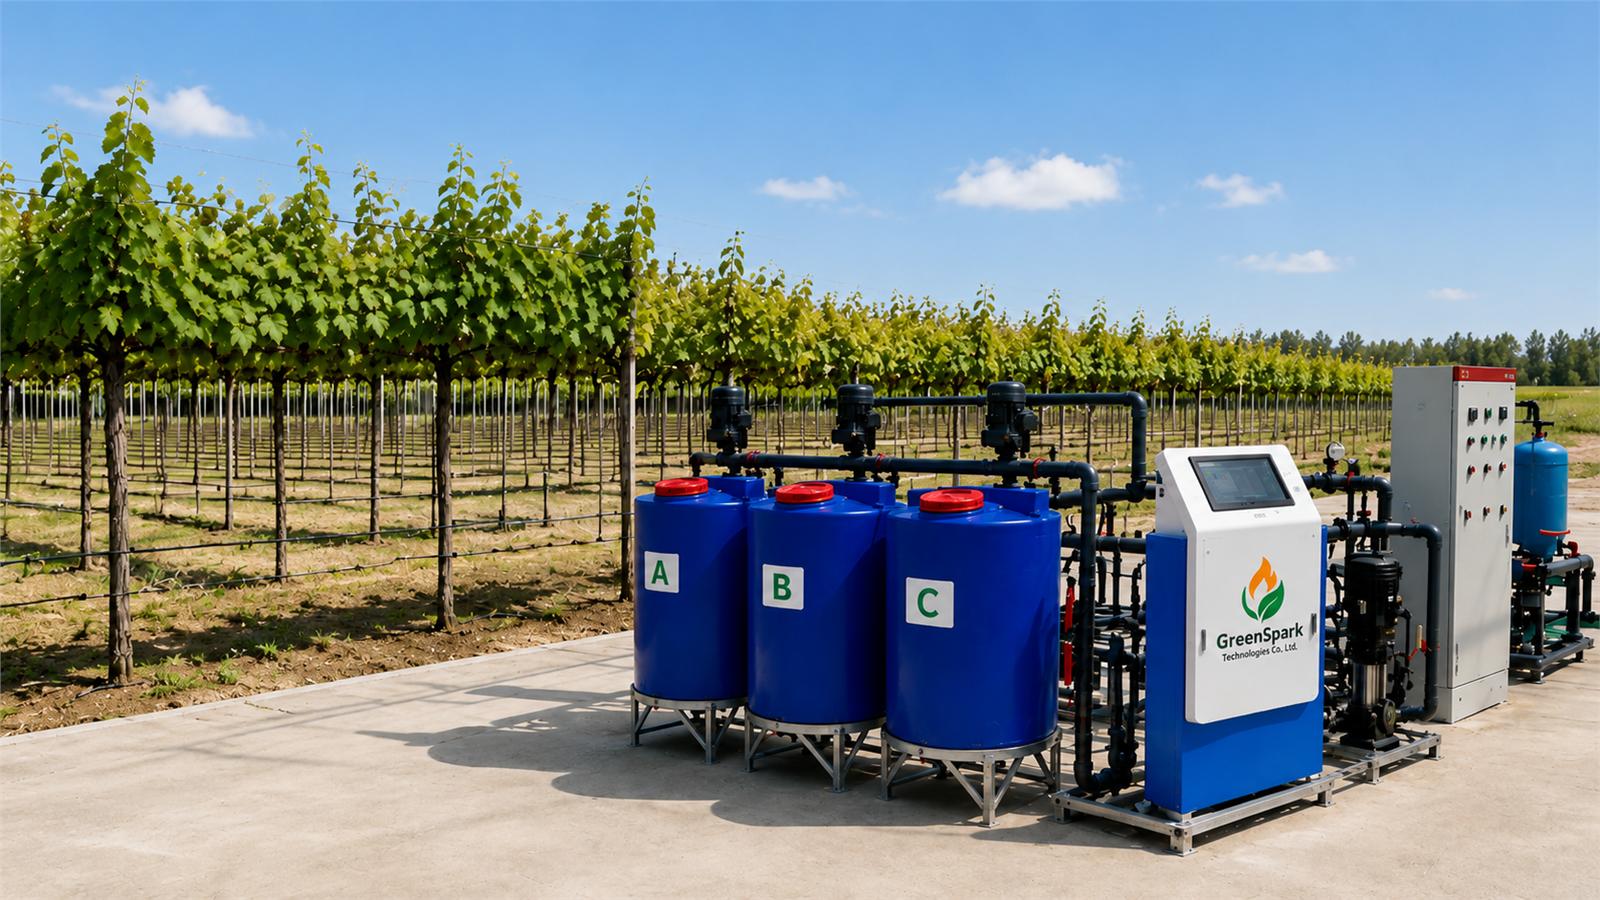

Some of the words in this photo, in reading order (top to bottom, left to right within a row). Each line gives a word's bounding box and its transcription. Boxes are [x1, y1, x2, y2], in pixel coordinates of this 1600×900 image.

[650, 560, 669, 586] A
[772, 573, 791, 601] B
[917, 587, 939, 618] C
[1216, 622, 1303, 649] GreenSpark
[1222, 648, 1270, 662] Technologies
[1284, 642, 1298, 652] Ltd.
